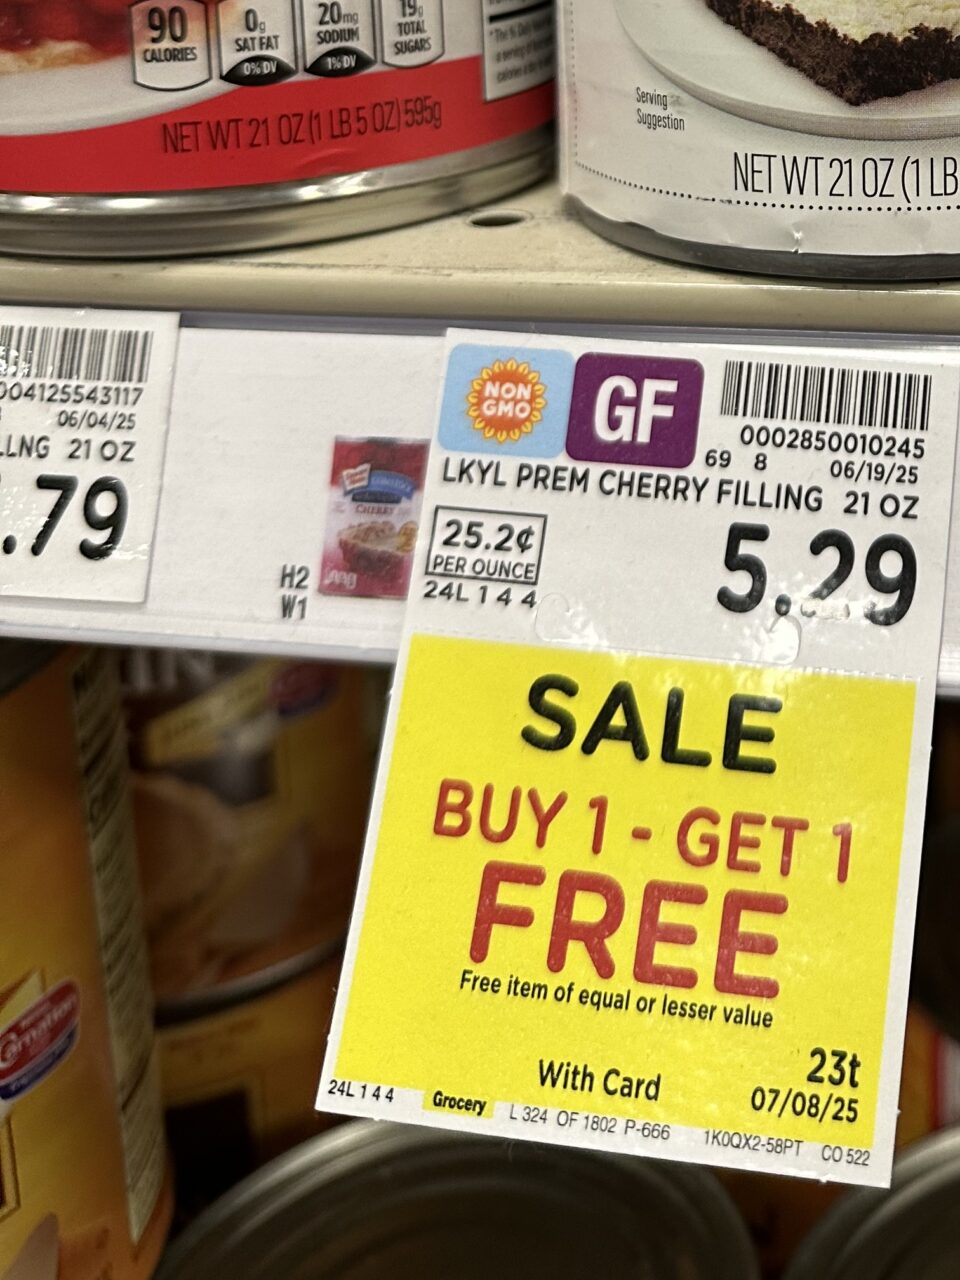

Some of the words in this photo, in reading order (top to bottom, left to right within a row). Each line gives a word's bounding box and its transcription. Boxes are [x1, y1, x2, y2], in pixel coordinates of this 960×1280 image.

[147, 6, 189, 44] 90
[143, 46, 198, 63] CALORIES
[484, 380, 533, 399] NON
[57, 410, 137, 431] 06/04/25
[481, 400, 531, 419] GMO
[594, 374, 679, 444] GF
[68, 438, 92, 460] 21
[100, 440, 137, 462] OZ
[740, 424, 925, 459] 0002850010245
[705, 449, 732, 468] 69
[754, 452, 768, 471] 8
[830, 459, 919, 485] 06/19/25
[442, 456, 507, 487] LKYL
[516, 462, 590, 493] PREM
[598, 469, 710, 503] CHERRY
[717, 478, 823, 512] FILLING
[843, 490, 870, 515] 21
[879, 493, 920, 519] OZ
[0, 473, 130, 561] .79
[442, 519, 535, 554] 25.2¢
[280, 564, 309, 591] H2
[433, 554, 468, 574] PER
[472, 557, 536, 580] OUNCE
[717, 521, 918, 627] 5.29
[281, 593, 307, 620] W1
[520, 672, 783, 774] SALE
[432, 777, 568, 849] BUY
[588, 794, 609, 855] 1
[676, 806, 809, 878] GET
[831, 822, 854, 884] 1
[468, 859, 790, 999] FREE
[460, 969, 503, 995] Free
[506, 974, 548, 1001] item
[553, 982, 574, 1002] of
[578, 988, 631, 1012] equal
[636, 995, 657, 1014] or
[661, 993, 718, 1021] lesser
[723, 1004, 774, 1029] value
[538, 1058, 595, 1094] With
[602, 1067, 662, 1102] Card
[806, 1047, 861, 1089] 23t
[432, 1089, 487, 1116] Grocery
[750, 1086, 859, 1124] 07/08/25
[509, 1103, 518, 1120] L
[522, 1106, 548, 1124] 324
[556, 1110, 579, 1129] OF
[583, 1112, 617, 1135] 1802
[624, 1119, 671, 1141] P-666
[821, 1144, 843, 1163] CO
[846, 1147, 871, 1167] 522
